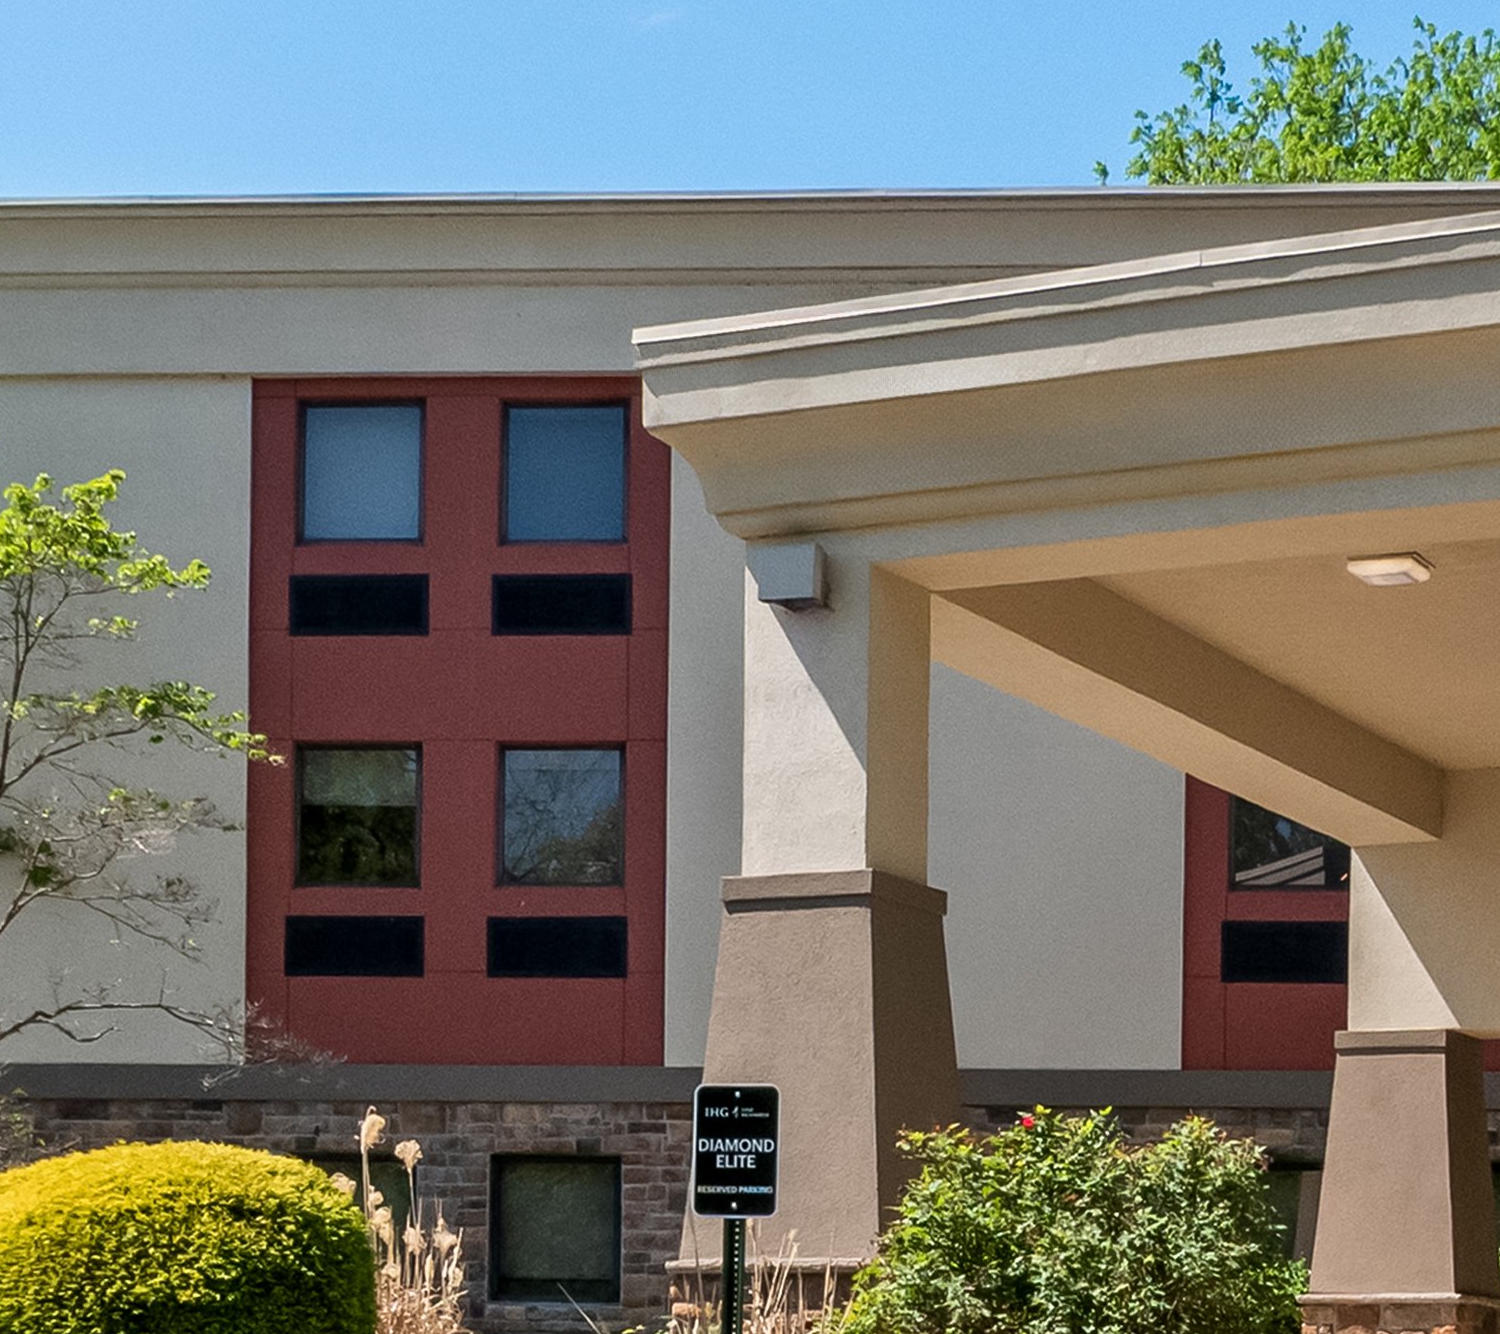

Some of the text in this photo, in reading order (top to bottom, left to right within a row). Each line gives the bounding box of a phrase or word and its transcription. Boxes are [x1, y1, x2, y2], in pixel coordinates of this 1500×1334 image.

[705, 1107, 729, 1118] IHG
[698, 1139, 775, 1153] DIAMOND
[716, 1155, 756, 1169] ELITE
[697, 1185, 773, 1194] RESERVED PARKING
